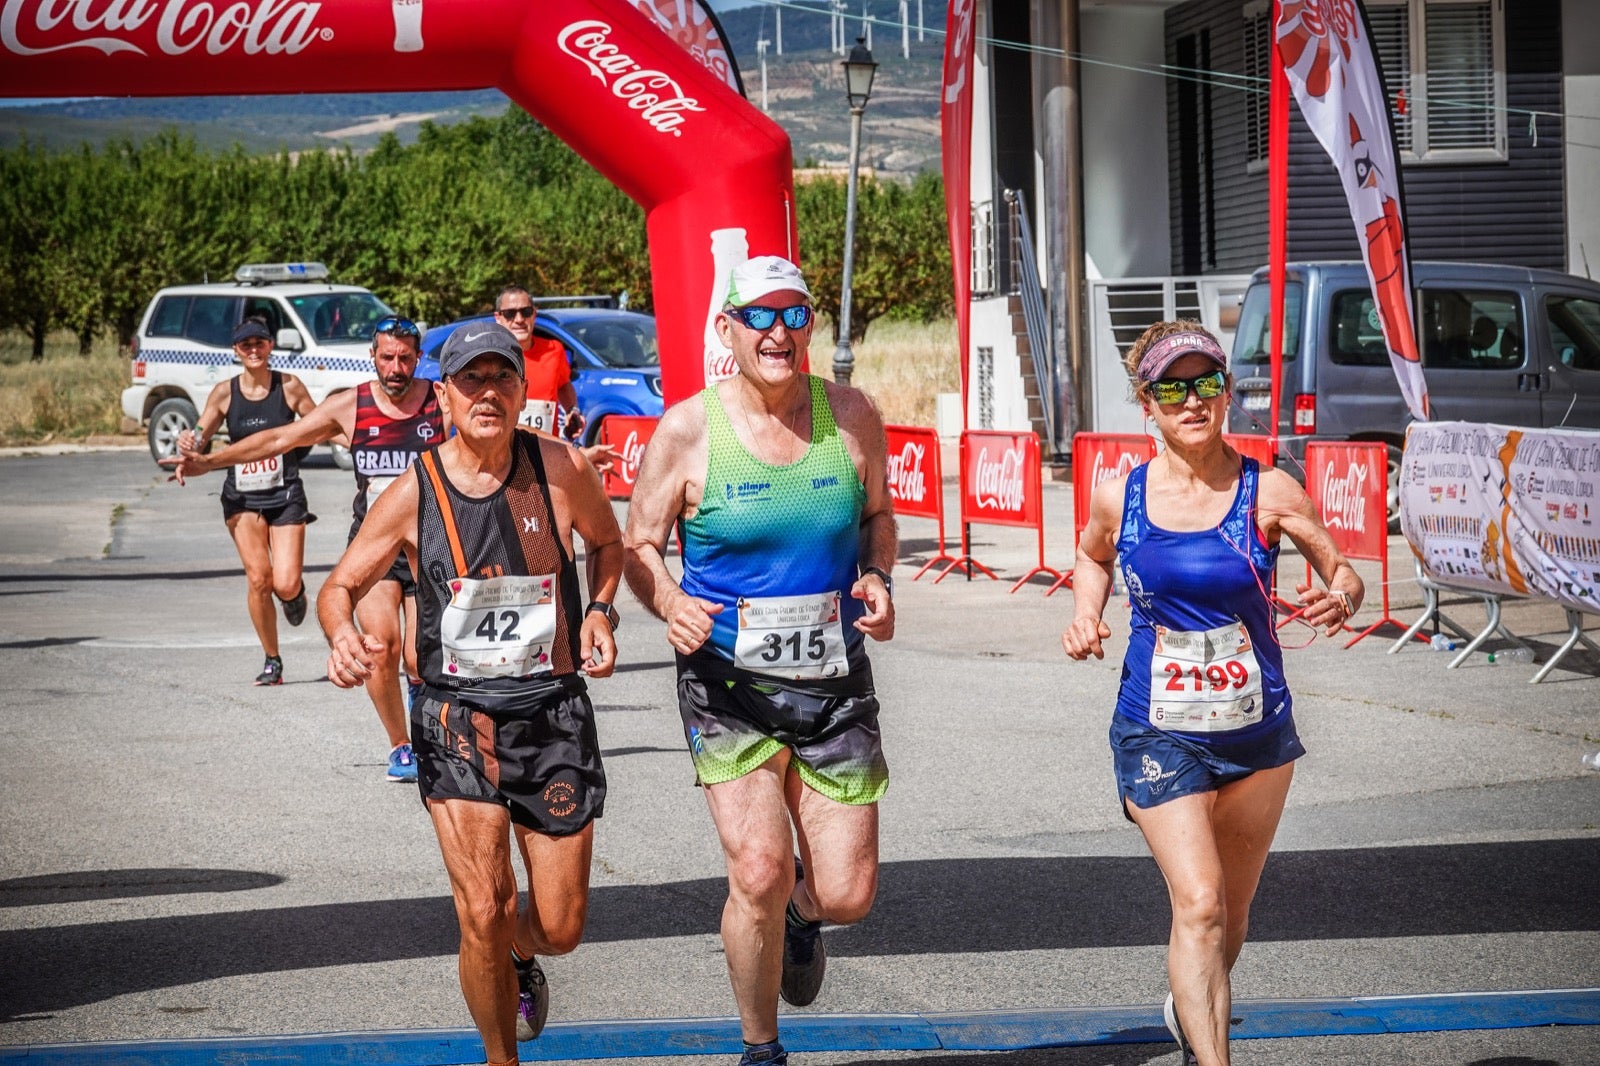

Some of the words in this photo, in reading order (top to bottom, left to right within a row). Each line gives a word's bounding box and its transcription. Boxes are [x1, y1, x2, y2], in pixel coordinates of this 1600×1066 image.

[476, 610, 520, 642] 42
[761, 629, 826, 662] 315
[1164, 660, 1248, 691] 2199
[543, 782, 575, 801] GRANADA
